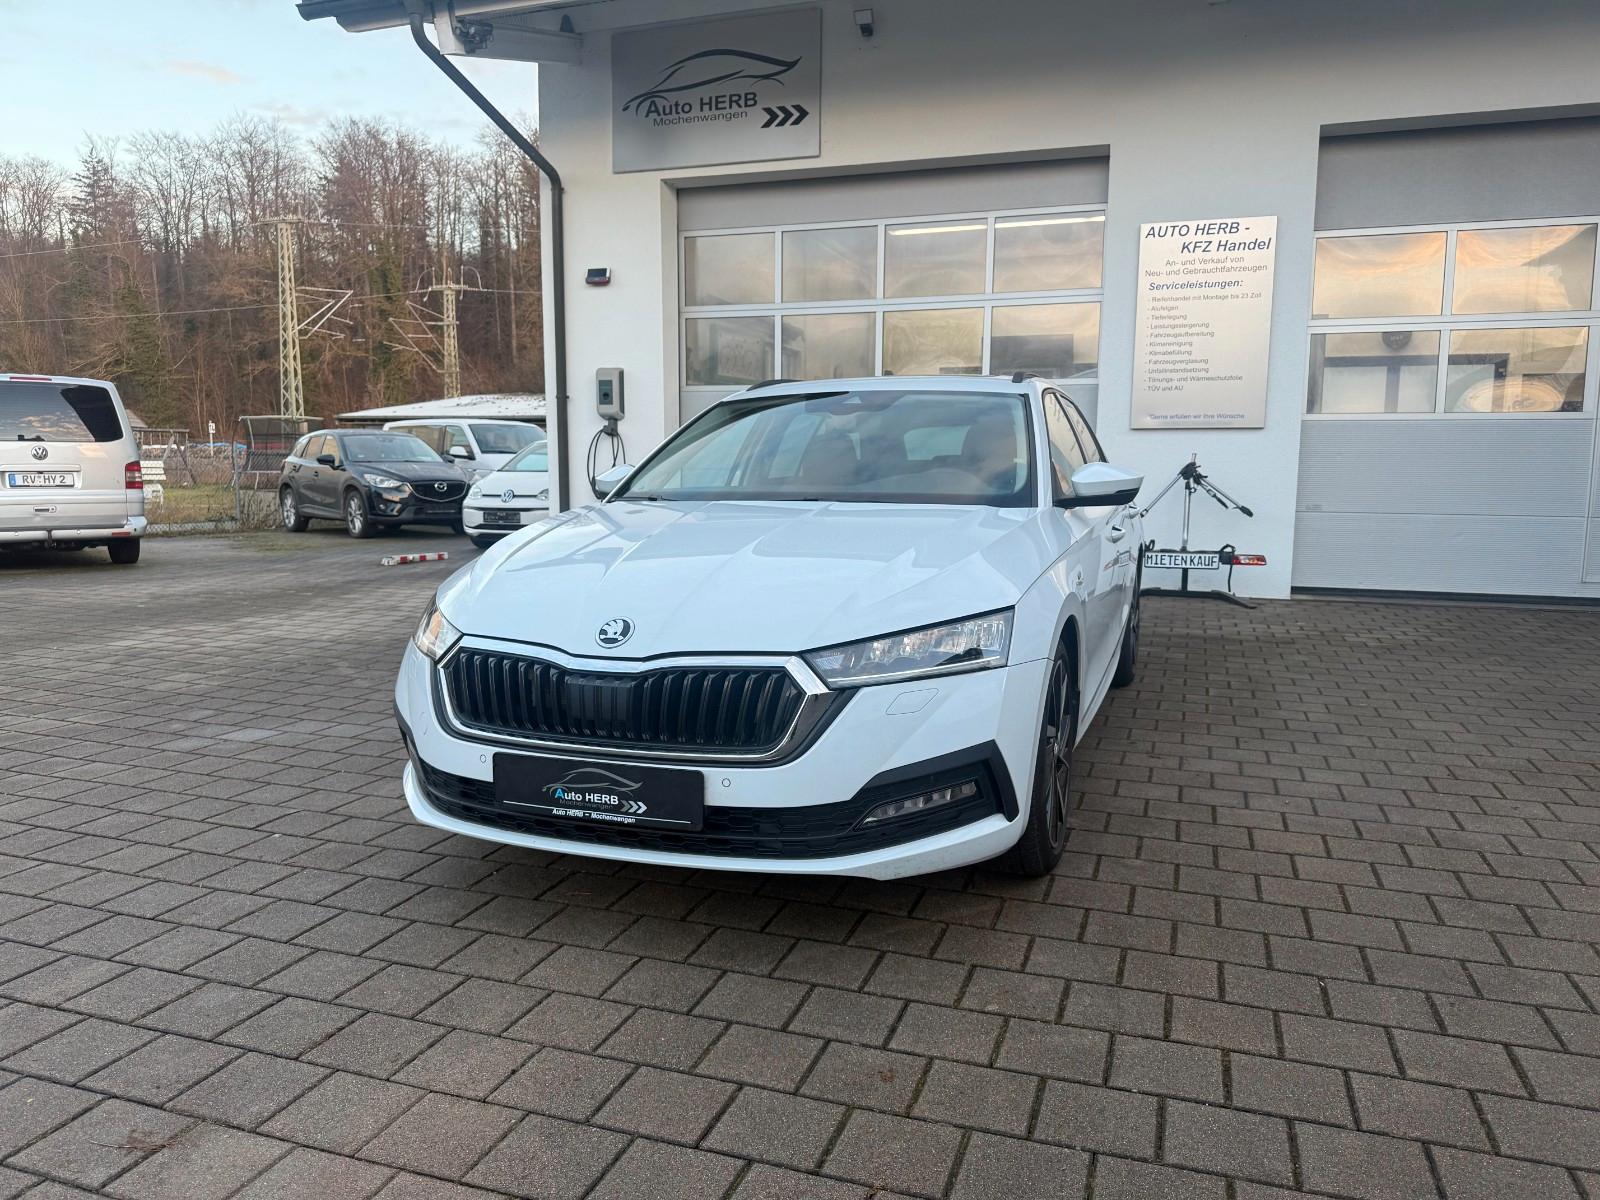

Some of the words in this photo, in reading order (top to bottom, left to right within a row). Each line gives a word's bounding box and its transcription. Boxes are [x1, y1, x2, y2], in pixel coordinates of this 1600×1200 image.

[645, 100, 693, 118] Auto
[700, 92, 758, 112] HERB
[653, 110, 748, 127] Mochenwangen
[1145, 224, 1190, 239] AUTO
[1195, 221, 1240, 236] HERB
[1180, 240, 1213, 254] KFZ
[1216, 237, 1272, 252] Handel
[1165, 259, 1179, 267] An-
[1181, 258, 1196, 266] und
[1198, 256, 1228, 265] Verkauf
[1230, 256, 1245, 264] von
[1145, 268, 1164, 277] Neu-
[1166, 268, 1181, 276] und
[1182, 264, 1268, 275] Gebrauchtfahrzeugen
[1148, 279, 1244, 291] Serviceleistungen:
[1202, 293, 1229, 302] Montage
[60, 475, 66, 484] 2
[554, 788, 583, 801] Auto
[585, 793, 619, 805] HERB
[552, 808, 566, 816] Auto
[566, 809, 584, 818] HERB
[590, 812, 636, 824] Mochenwangen
